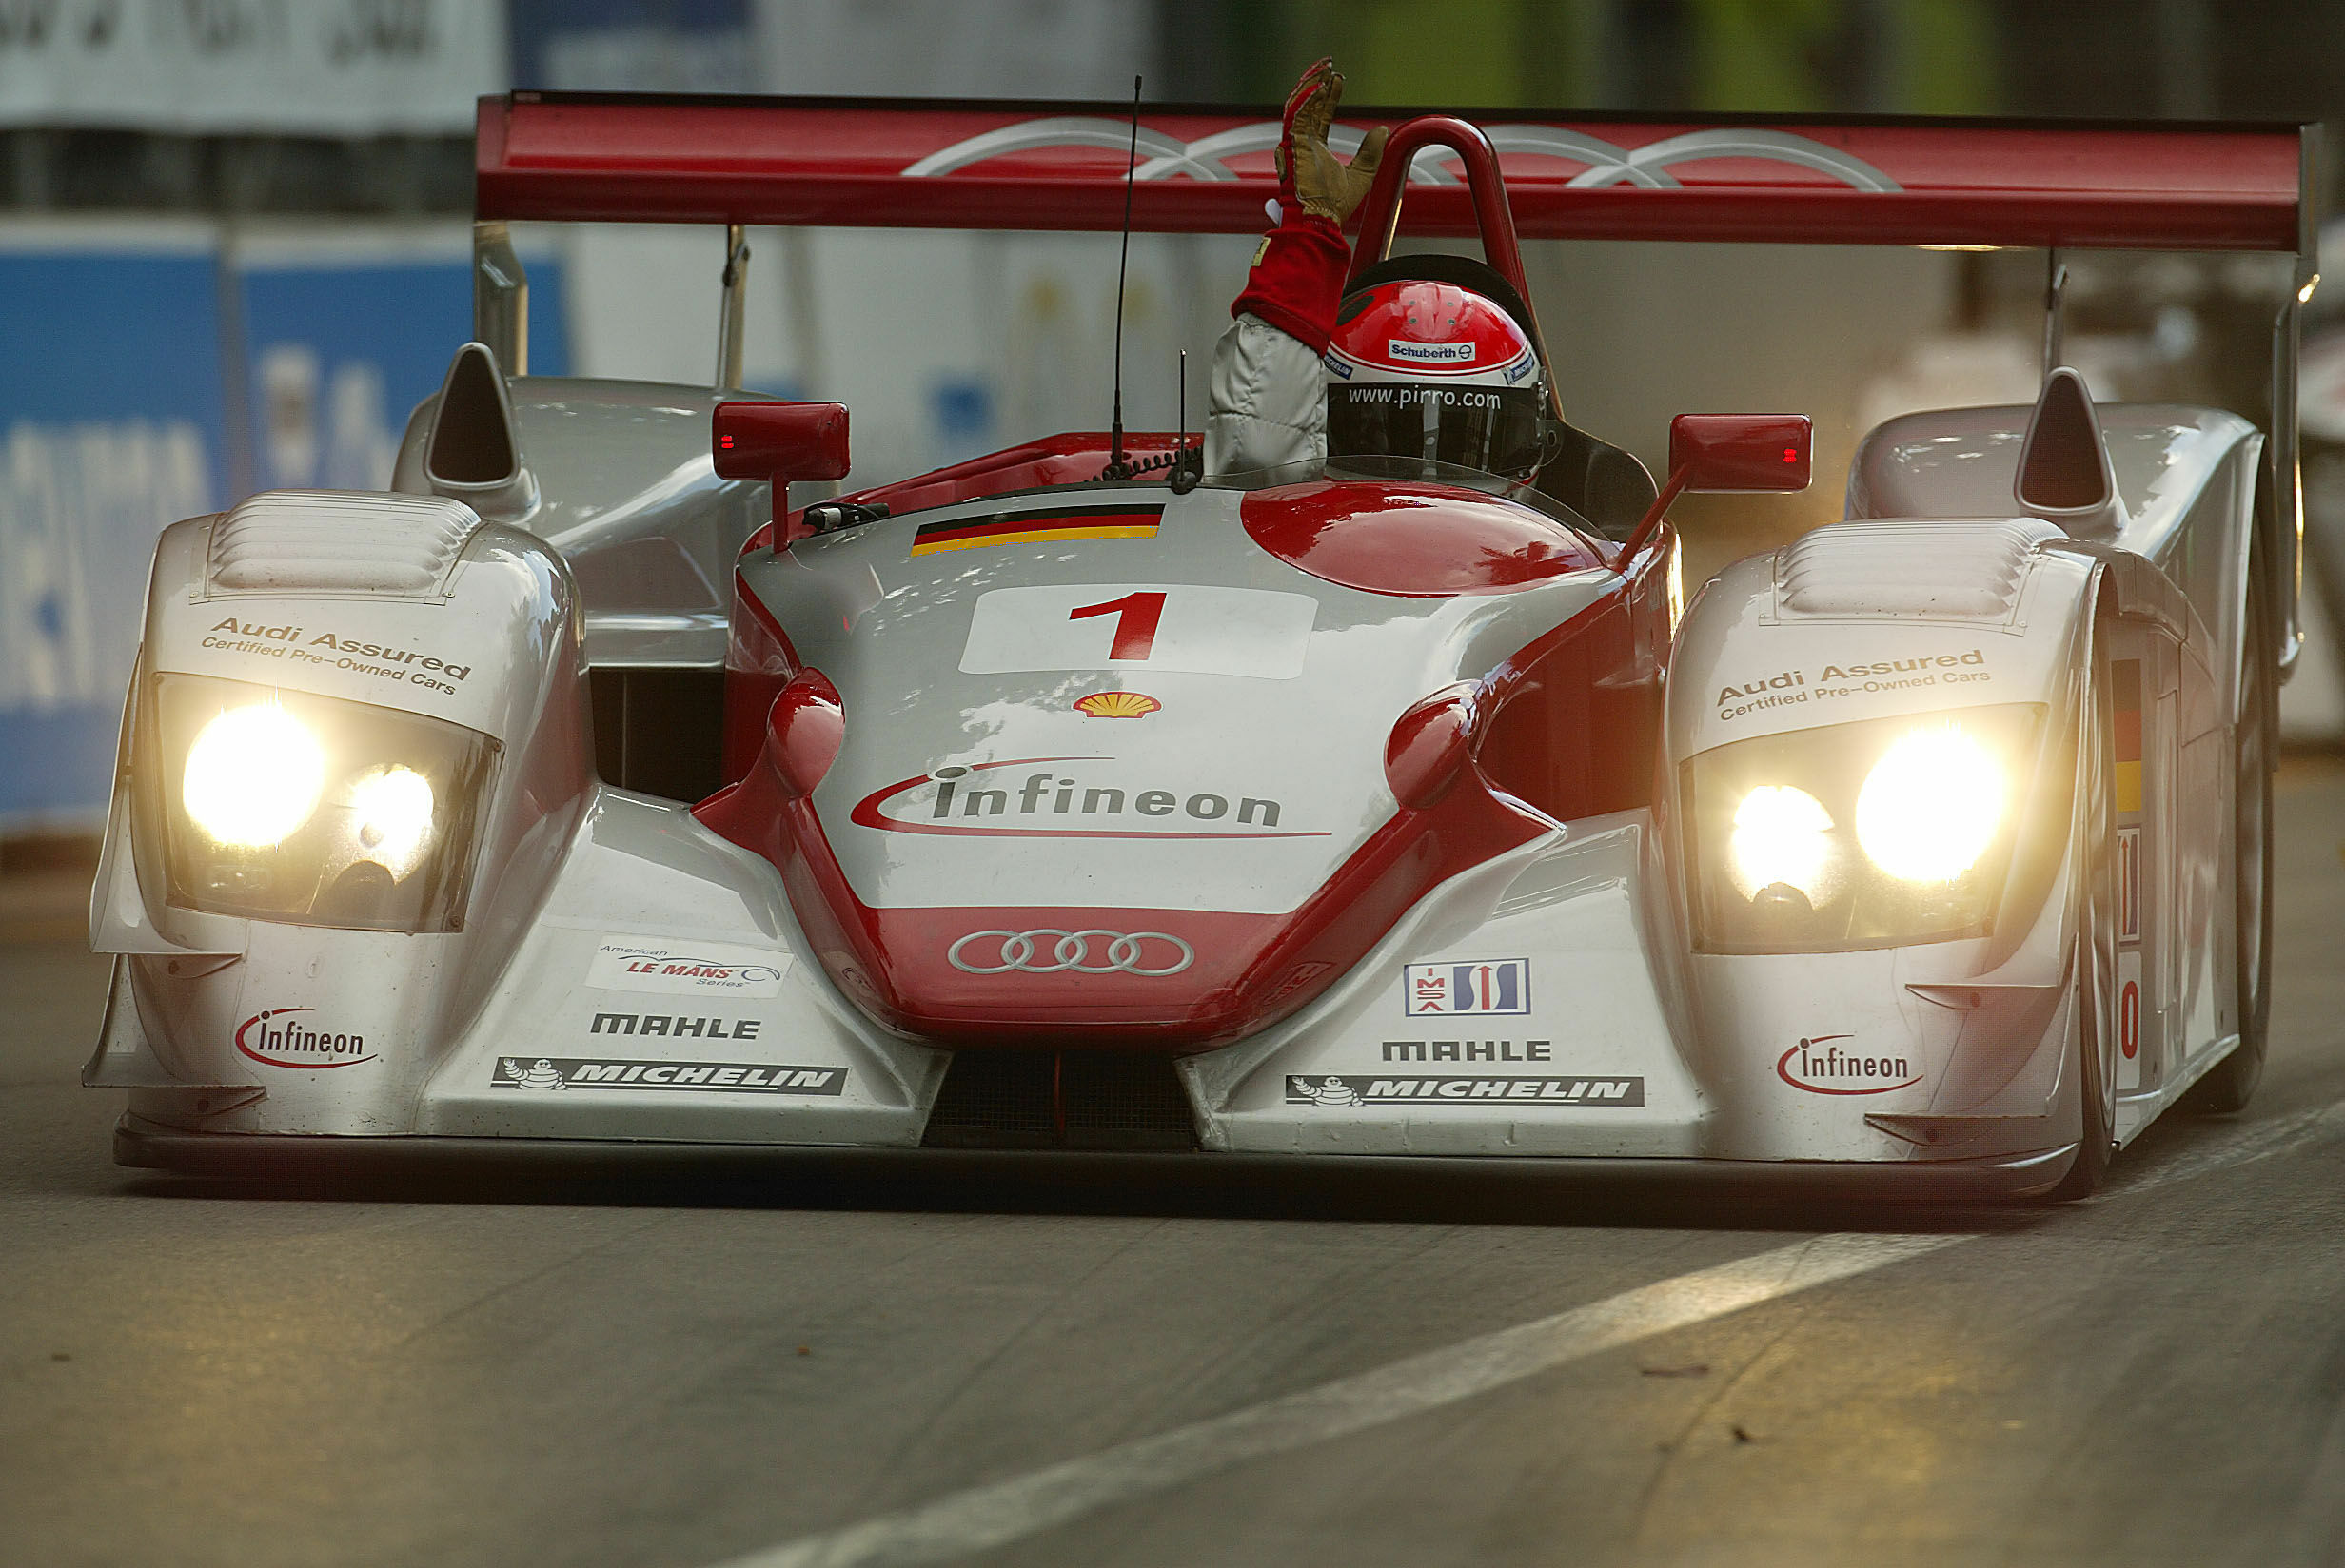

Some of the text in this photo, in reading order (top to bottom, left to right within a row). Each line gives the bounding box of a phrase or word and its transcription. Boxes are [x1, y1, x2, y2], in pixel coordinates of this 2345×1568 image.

[1391, 343, 1457, 359] Schuberth
[1348, 385, 1502, 410] www.pirro.com
[1069, 591, 1168, 661] 1
[210, 617, 471, 681] Audi Assured
[201, 637, 457, 696] Certified Pre-Owned Cars
[1716, 649, 1985, 707] Audi Assured
[1720, 668, 1991, 721] Certified Pre-Owned Cars
[600, 944, 668, 957] American
[626, 961, 734, 980] LE MANS
[696, 977, 743, 989] Series
[590, 1012, 762, 1041] MAHLE
[1382, 1040, 1551, 1062] MAHLE
[570, 1063, 835, 1088] MICHELIN
[1365, 1079, 1631, 1100] MICHELIN
